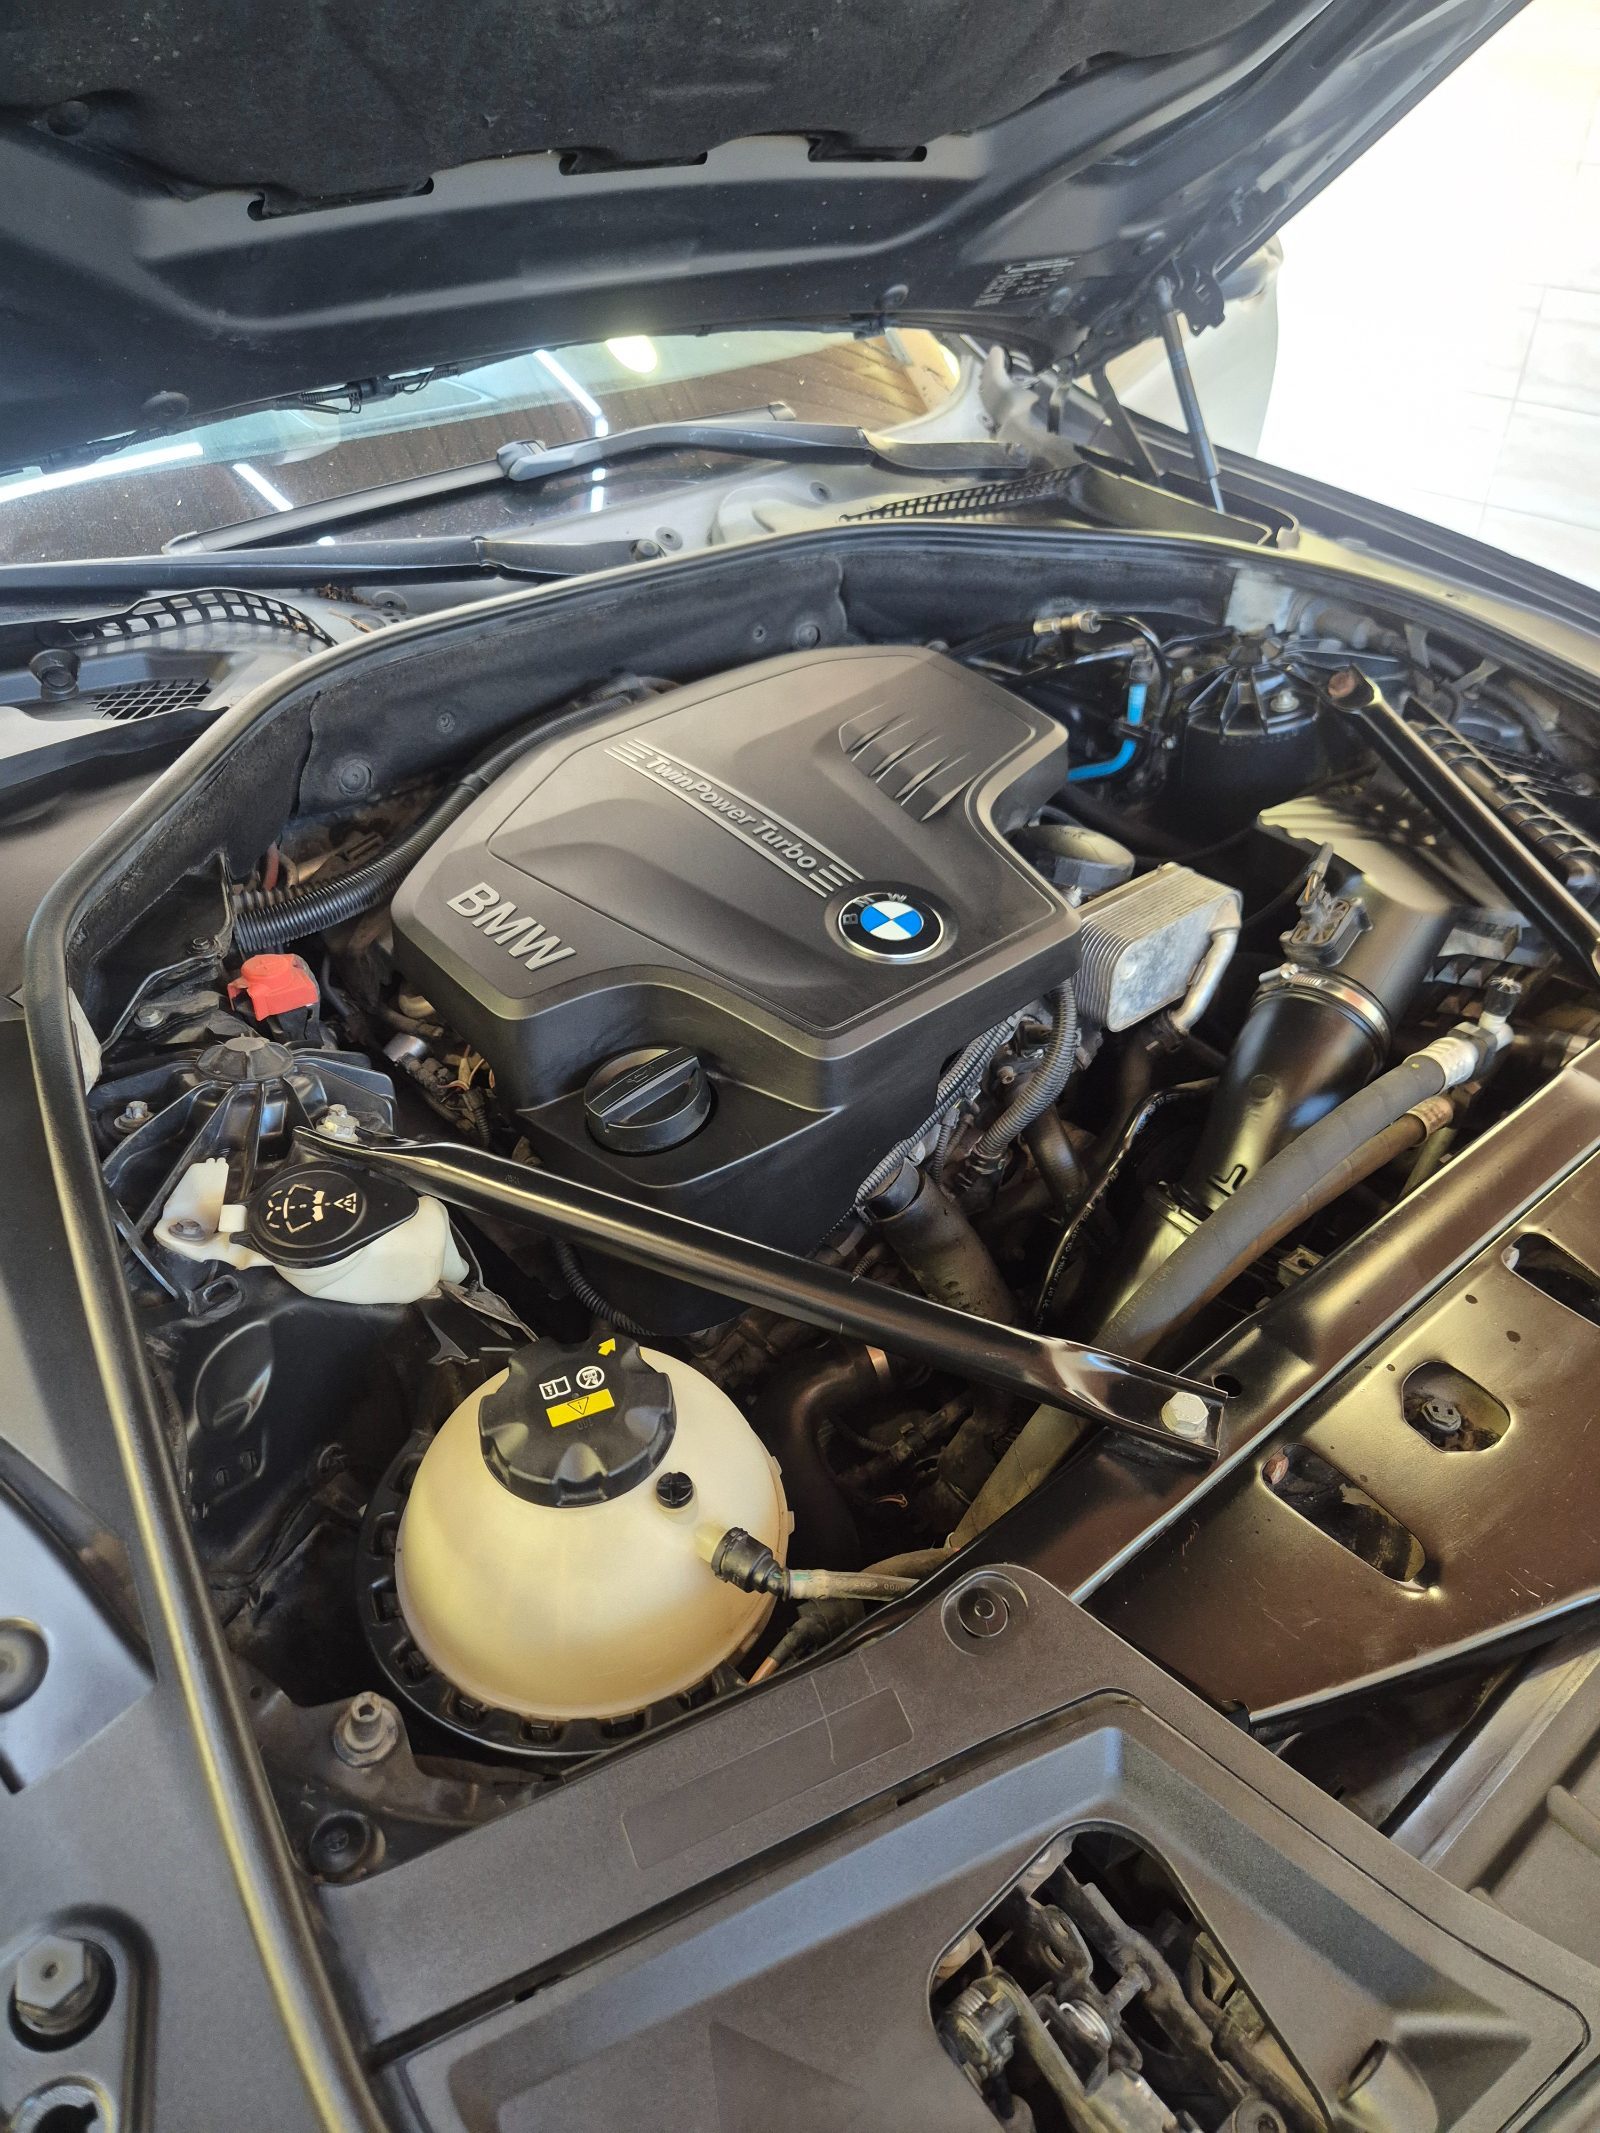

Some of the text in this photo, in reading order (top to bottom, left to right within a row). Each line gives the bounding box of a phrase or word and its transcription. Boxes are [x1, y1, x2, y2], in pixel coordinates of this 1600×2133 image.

[645, 757, 817, 869] TwinPower Turbo
[446, 881, 577, 971] BMW
[842, 892, 908, 926] BMW
